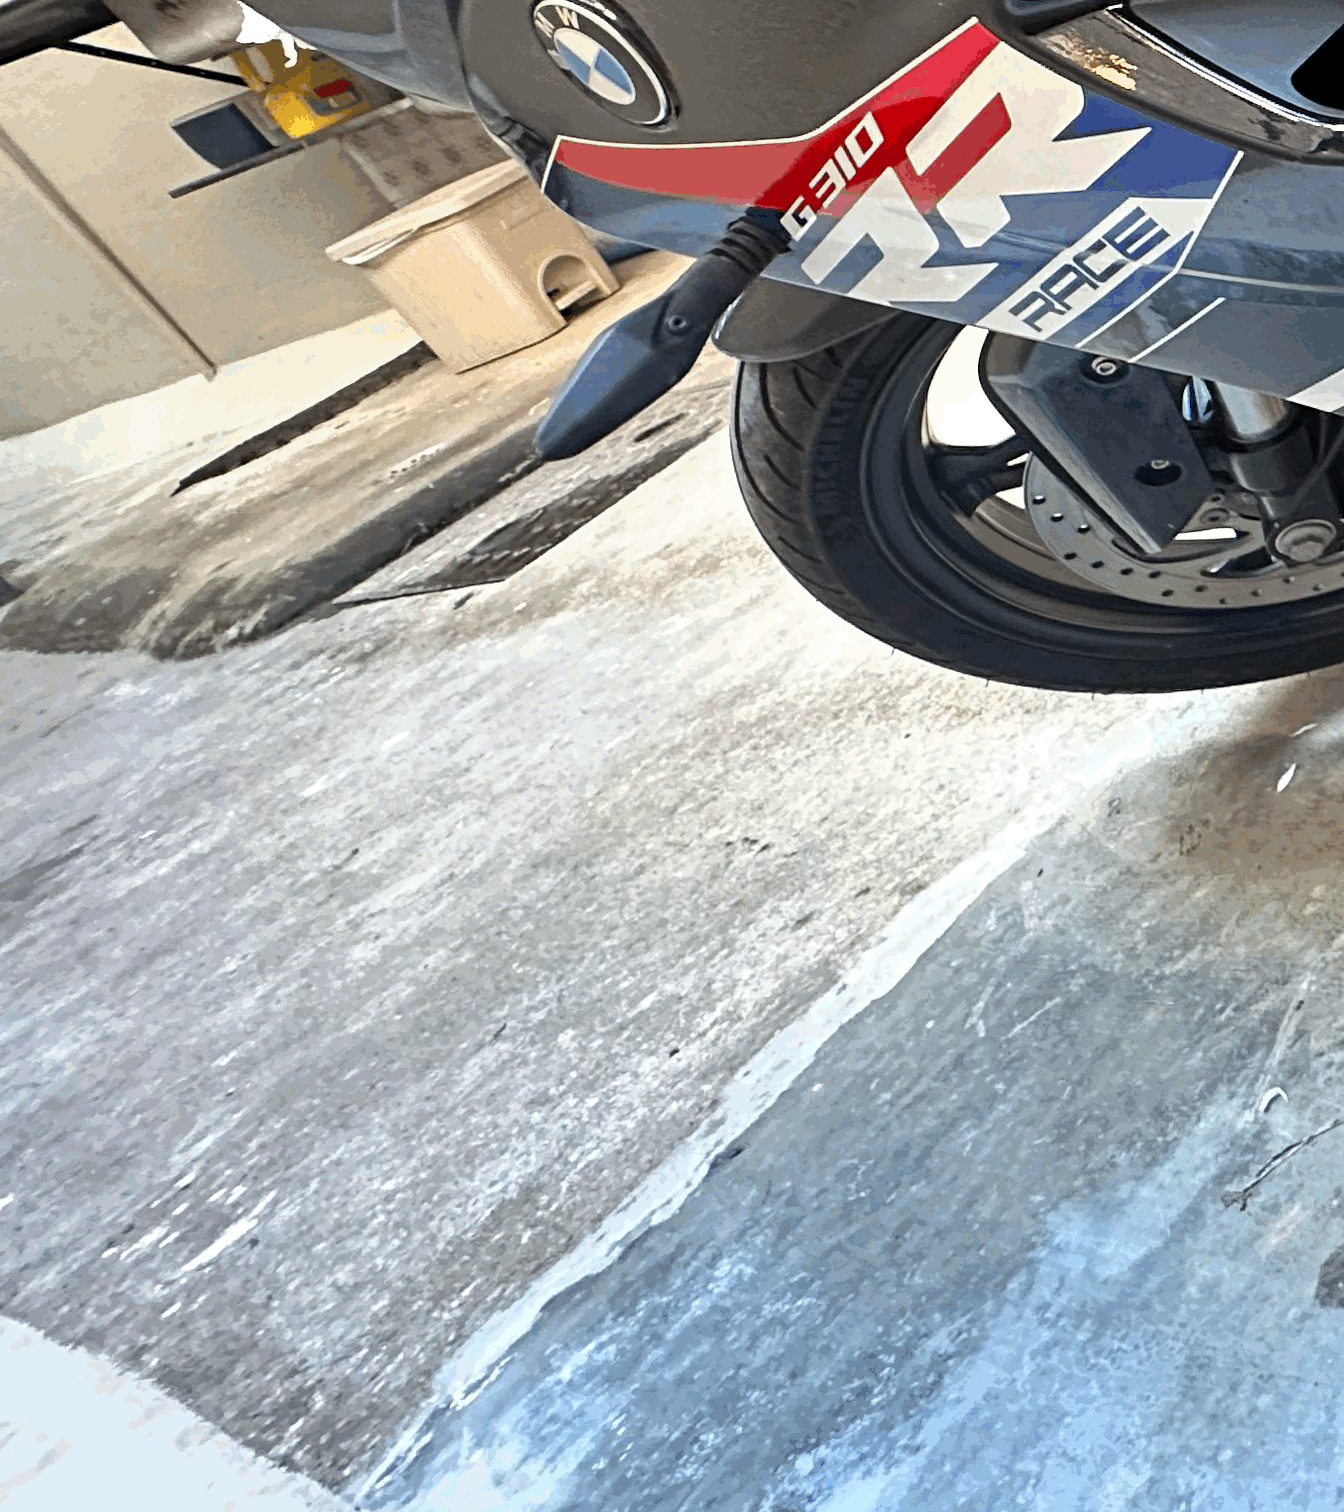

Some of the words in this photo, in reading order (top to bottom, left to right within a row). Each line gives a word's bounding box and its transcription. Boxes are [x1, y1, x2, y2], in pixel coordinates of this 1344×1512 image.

[779, 194, 818, 243] G
[808, 110, 885, 210] 310
[1008, 205, 1171, 333] RACE
